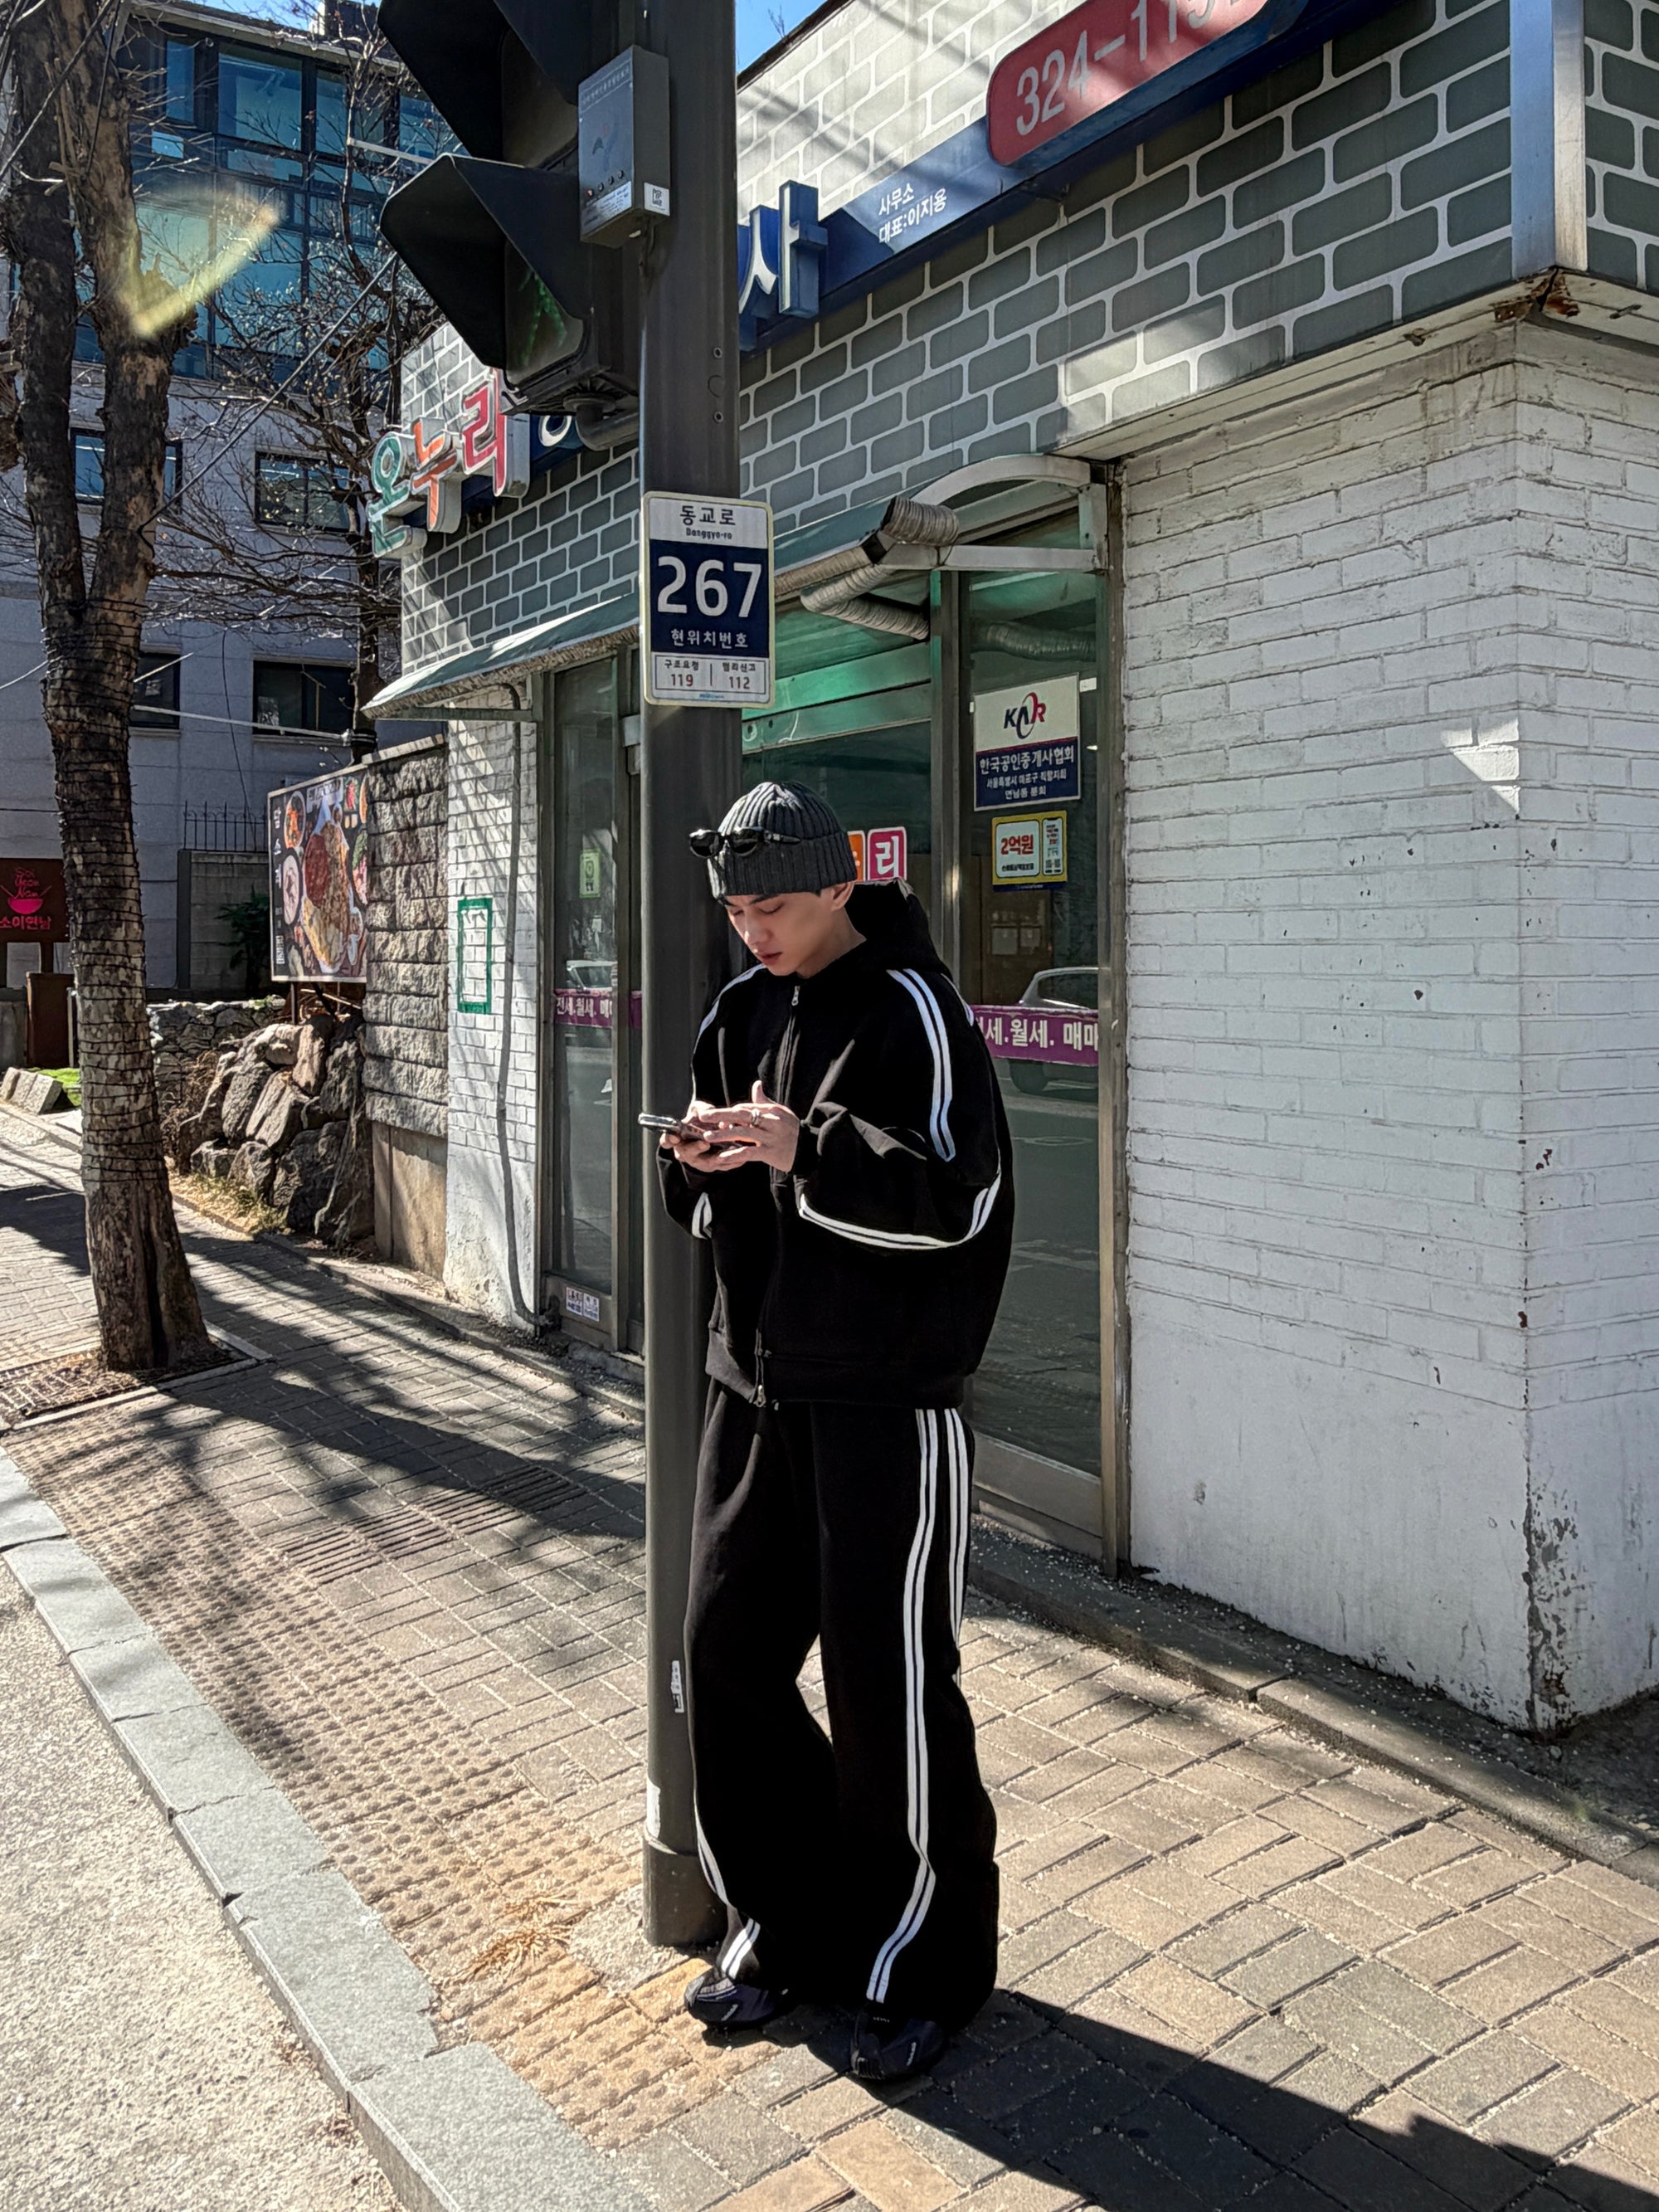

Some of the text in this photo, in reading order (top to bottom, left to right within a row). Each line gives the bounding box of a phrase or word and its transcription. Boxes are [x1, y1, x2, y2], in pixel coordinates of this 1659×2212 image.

[1016, 0, 1241, 136] 324-11
[878, 183, 914, 216] 사무소
[879, 188, 947, 243] 대표:이지용
[365, 368, 508, 558] 온누리
[679, 504, 737, 526] 동교로
[685, 527, 732, 540] Donggyo-ro
[657, 555, 762, 618] 267
[671, 628, 748, 649] 현위치번호
[671, 674, 751, 690] 119 112
[1004, 691, 1047, 739] KAR
[980, 745, 1075, 775] 한국공인중개사협회
[1000, 833, 1034, 855] 2억원
[0, 915, 51, 930] 소이연남
